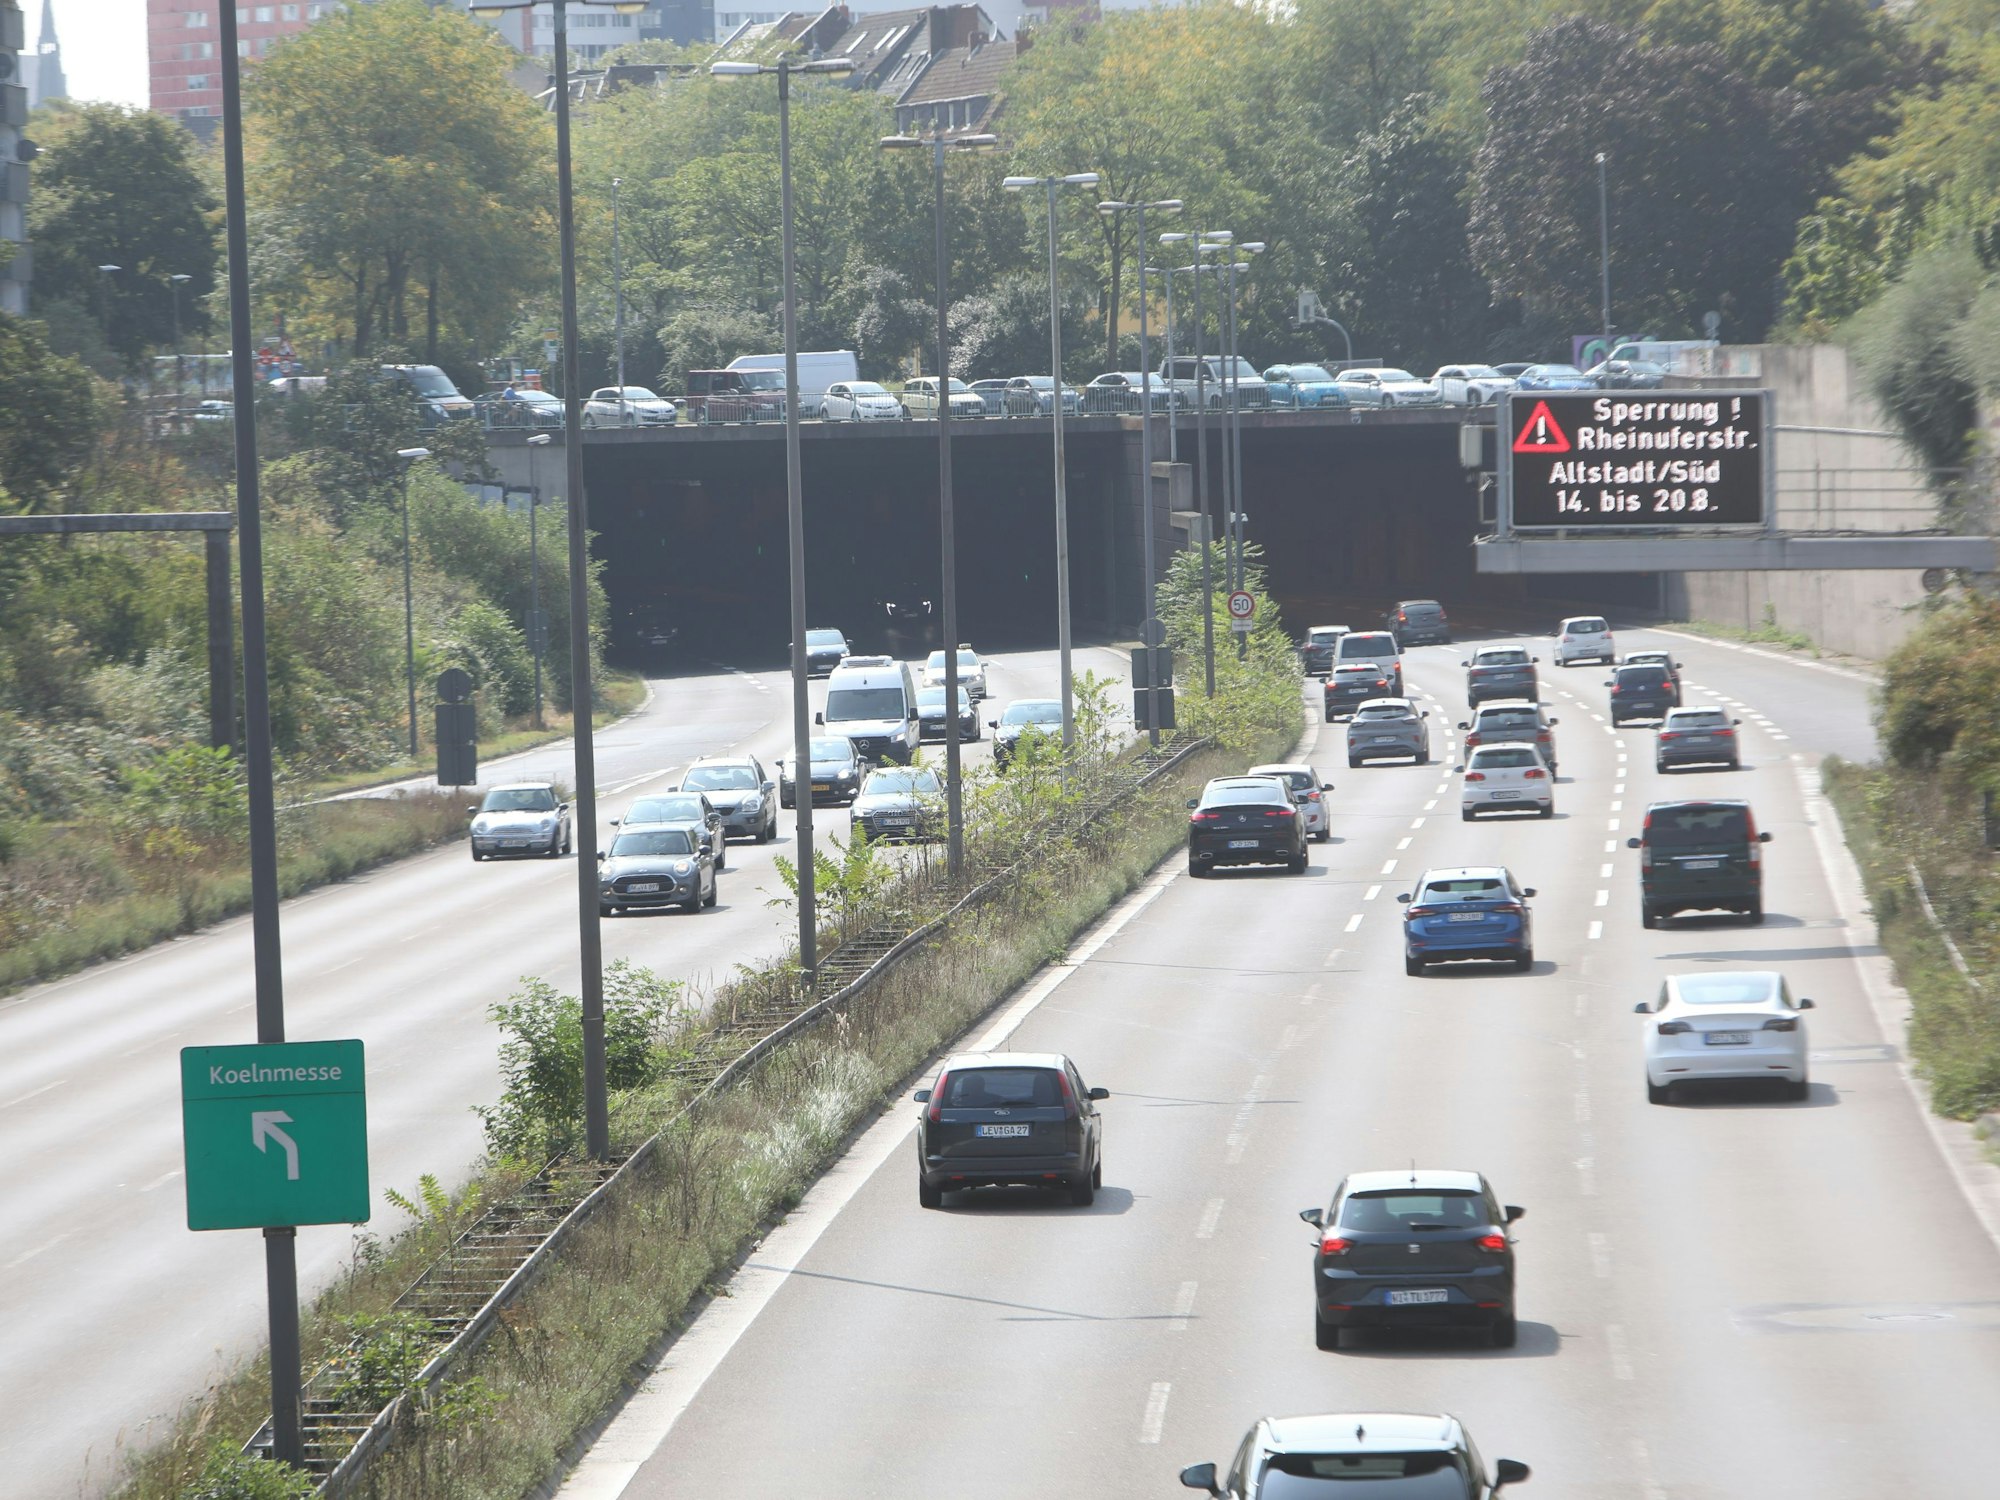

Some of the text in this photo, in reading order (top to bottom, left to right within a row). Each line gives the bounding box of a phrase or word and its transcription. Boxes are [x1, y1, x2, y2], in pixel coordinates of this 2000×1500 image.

[1593, 396, 1741, 427] Sperrung !
[1577, 425, 1758, 450] Rheinuferstr.
[1548, 459, 1721, 484] Altstadt/Süd
[1556, 489, 1591, 513] 14.
[1600, 489, 1642, 513] bis
[1233, 598, 1249, 612] 50
[209, 1063, 342, 1085] Koelnmesse
[982, 1126, 1028, 1135] LEV GA 27
